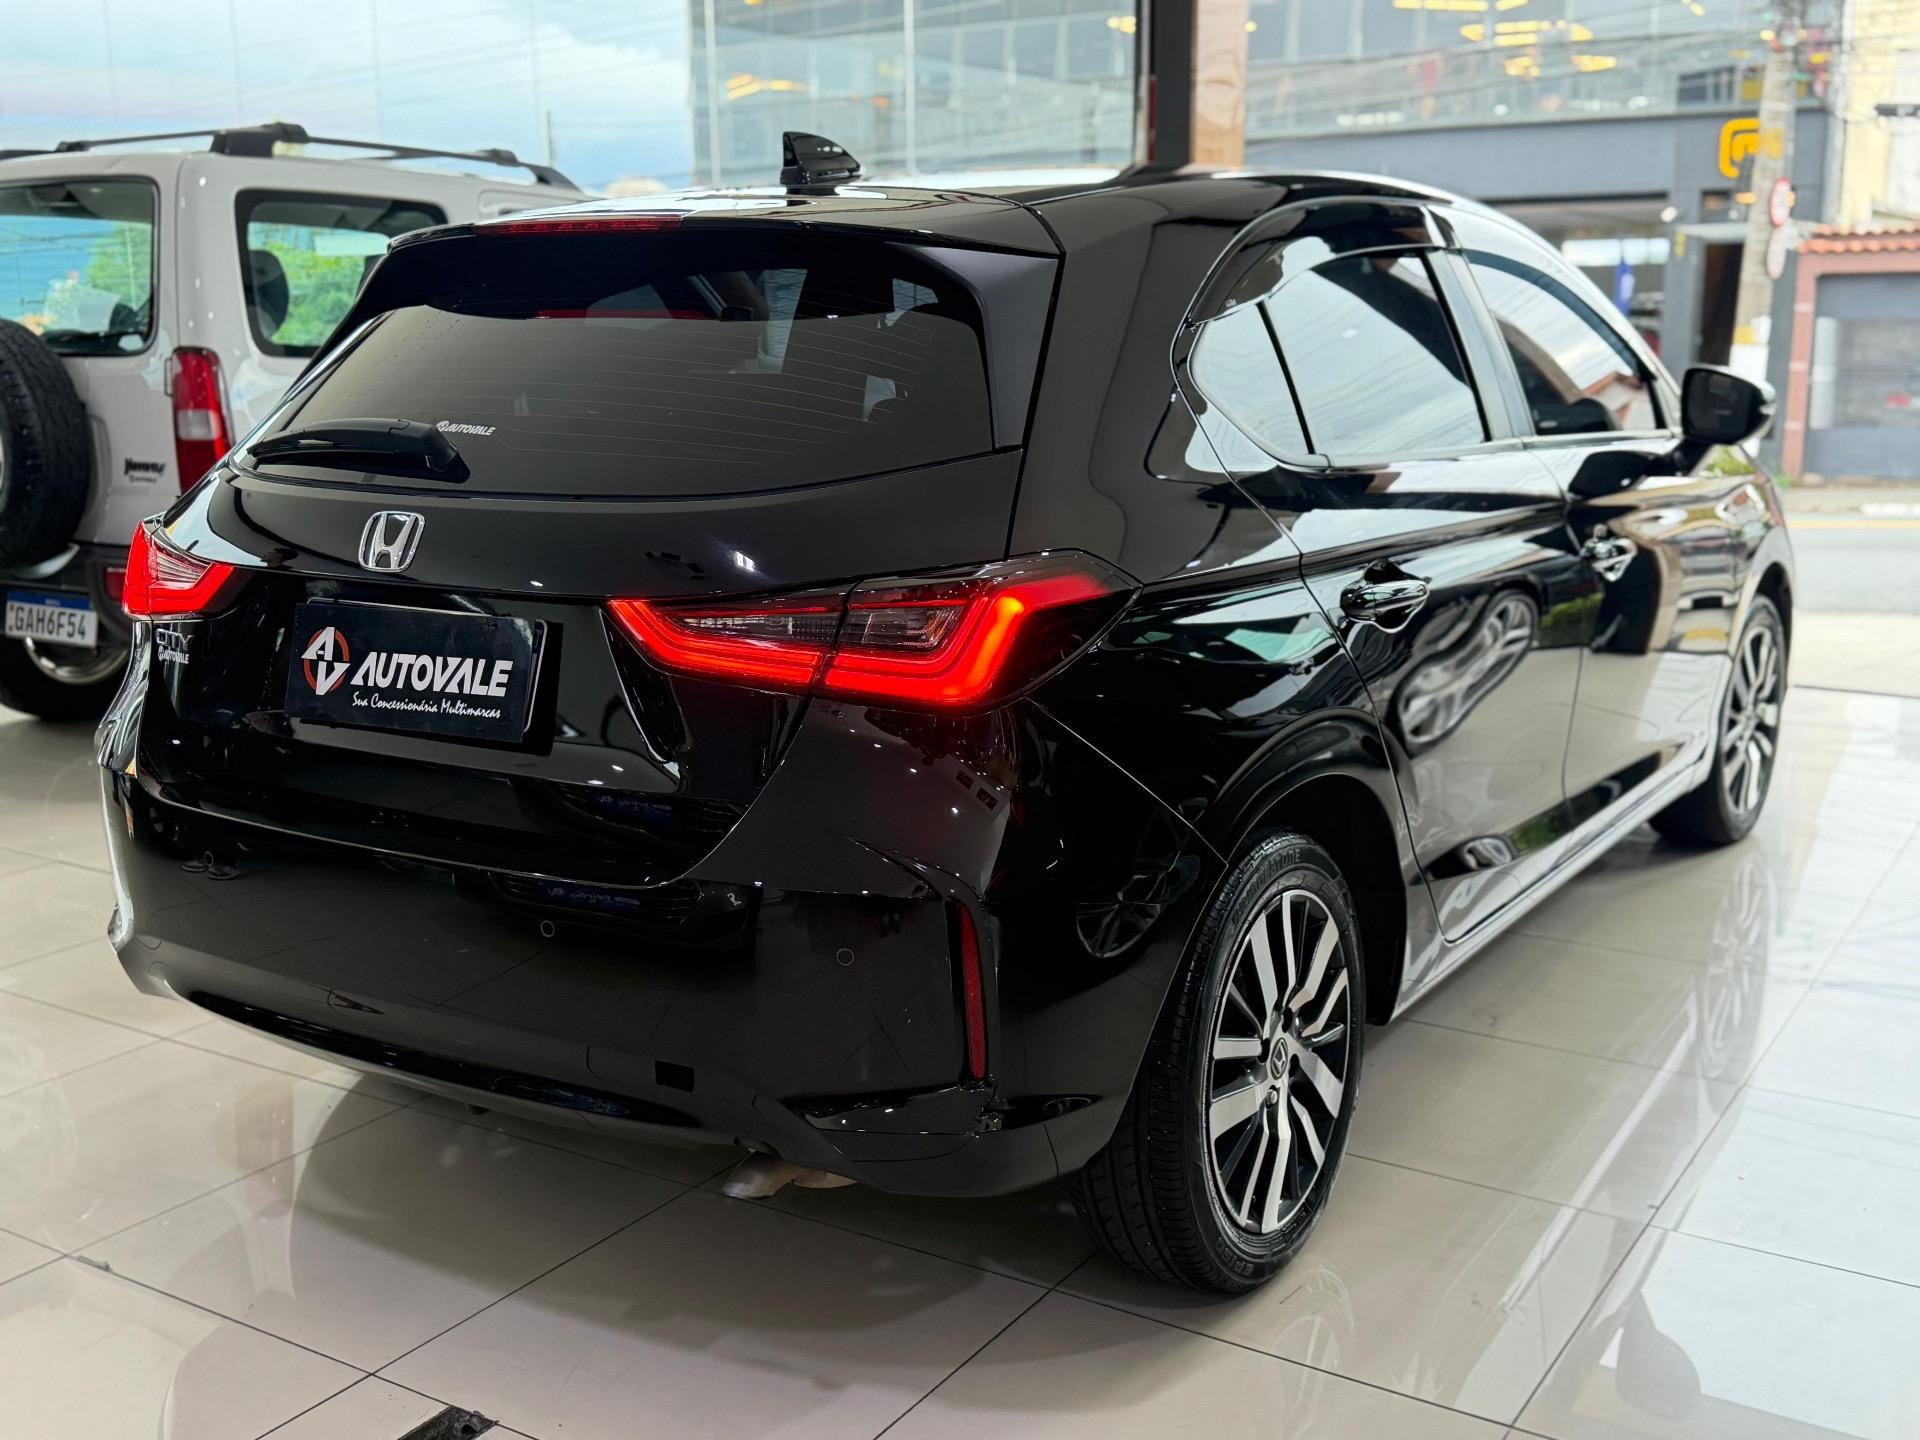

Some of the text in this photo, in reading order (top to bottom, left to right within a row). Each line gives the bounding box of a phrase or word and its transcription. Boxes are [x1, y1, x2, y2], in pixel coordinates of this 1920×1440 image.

[447, 423, 496, 436] AUTOVALE
[15, 606, 86, 640] GAH6F54
[350, 651, 514, 697] AUTOVALE
[352, 691, 501, 719] Sua Concessionária Multimarcas
